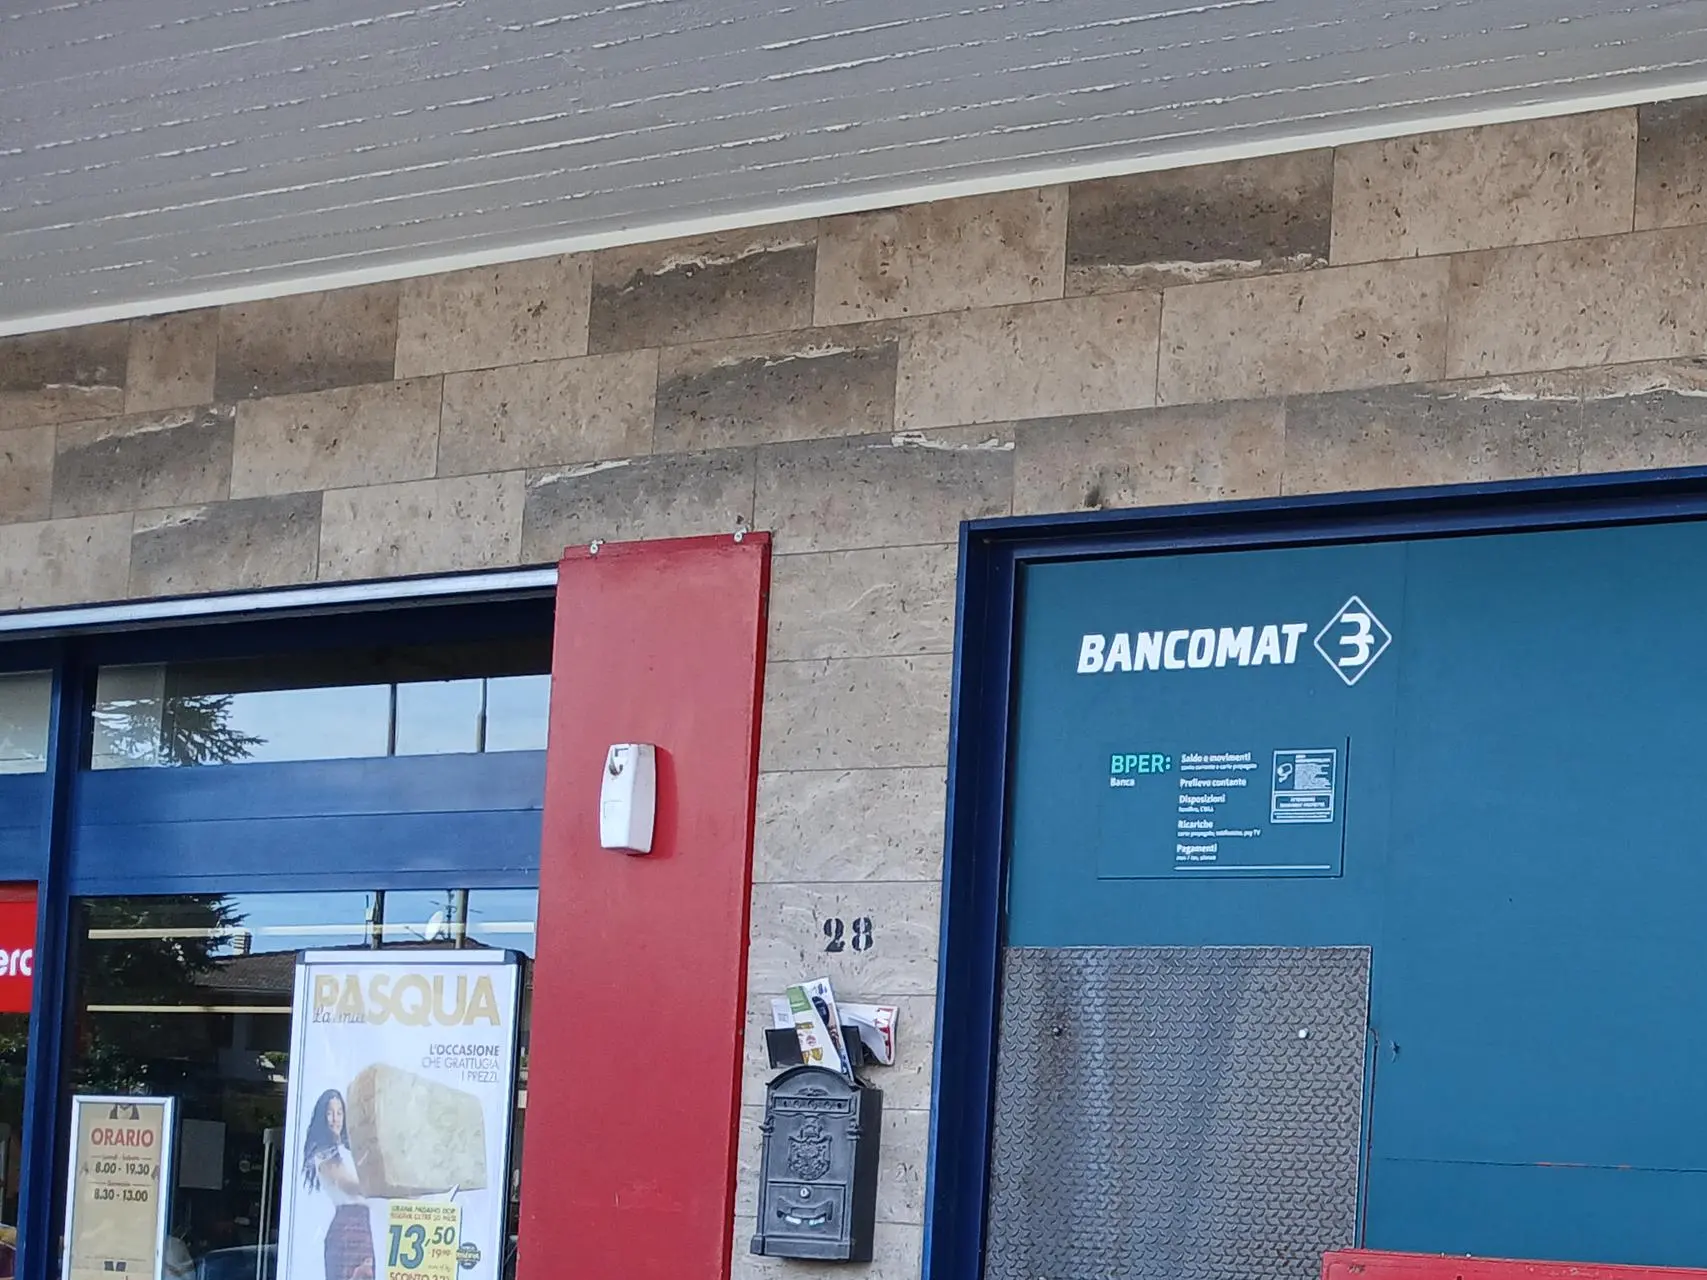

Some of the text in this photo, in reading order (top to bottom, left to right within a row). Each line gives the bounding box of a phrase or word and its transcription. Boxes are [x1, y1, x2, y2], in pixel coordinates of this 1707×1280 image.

[1077, 623, 1308, 674] BANCOMAT
[1181, 753, 1202, 763] Saldo
[1209, 752, 1251, 762] movimenti
[1110, 777, 1135, 787] Banca
[1180, 778, 1211, 788] Prelievo
[1179, 794, 1226, 805] Disposizioni
[1178, 820, 1213, 828] Ricariche
[1177, 843, 1217, 854] Pagamenti
[823, 917, 873, 952] 28
[313, 974, 501, 1026] PASQUA
[429, 1044, 500, 1056] L'OCCASIONE
[422, 1057, 499, 1070] CHE GRATTUGIA
[91, 1128, 154, 1148] ORARIO
[95, 1161, 117, 1174] 8.00
[126, 1163, 150, 1175] 19.30
[94, 1188, 115, 1200] 8.30
[122, 1189, 149, 1202] 13.00
